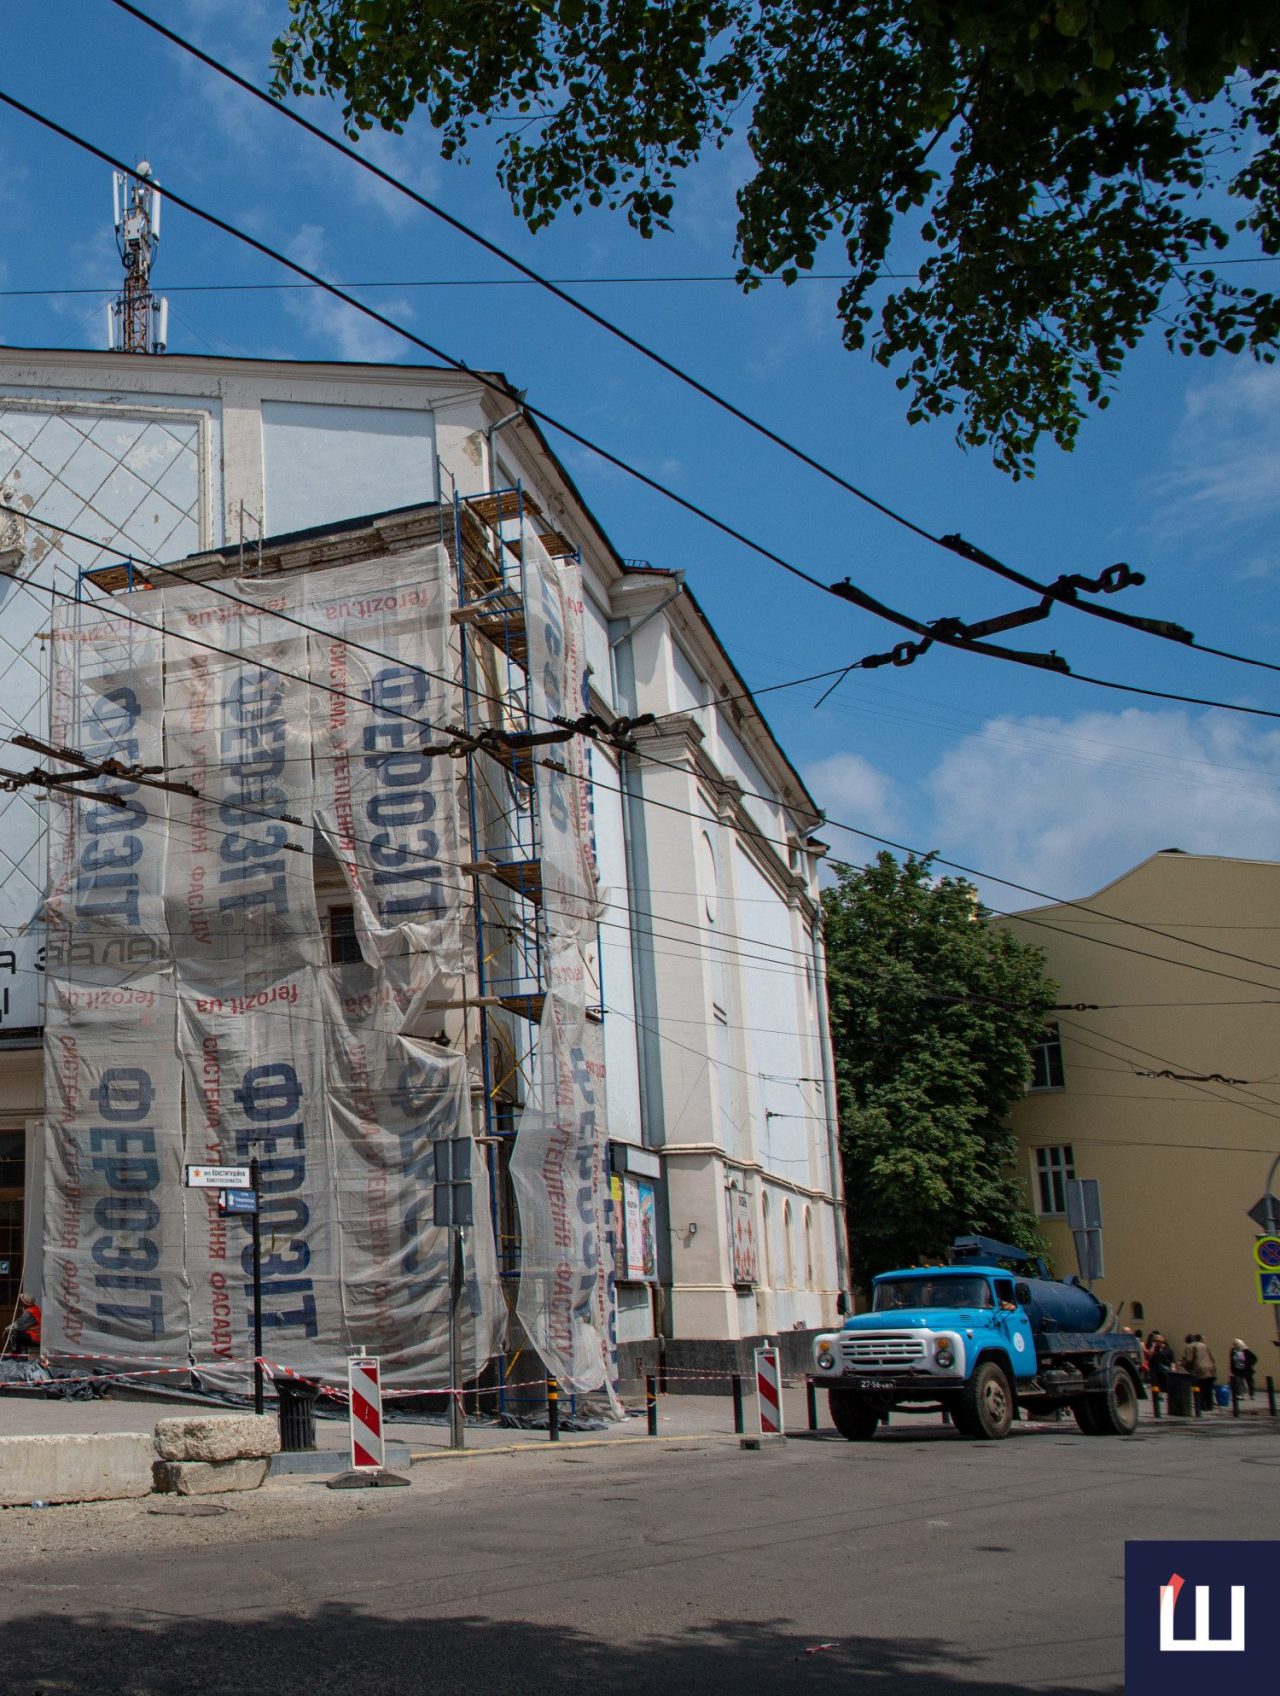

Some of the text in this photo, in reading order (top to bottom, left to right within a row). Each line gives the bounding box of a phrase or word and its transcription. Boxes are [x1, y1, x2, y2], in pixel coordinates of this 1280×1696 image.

[324, 588, 429, 622] ferozit.ua
[188, 654, 209, 735] СИСТЕМА
[326, 643, 349, 729] СИСТЕМА
[219, 671, 290, 915] ФЕРОЗІТ
[332, 741, 357, 851] УТЕПЛЕННЯ
[363, 665, 444, 922] ФЕРОЗІТ
[195, 983, 298, 1015] ferozit.ua
[201, 1037, 222, 1130] СИСТЕМА
[59, 1035, 82, 1346] СИСТЕМА УТЕПЛЕННЯ ФАСАДУ
[89, 1067, 166, 1334] ФЕРОЗІТ
[233, 1062, 319, 1338] ФЕРОЗІТ
[542, 1121, 573, 1249] УТЕПЛЕННЯ
[209, 1272, 233, 1360] ФАСАДУ
[551, 1262, 577, 1360] ФАСАДУ
